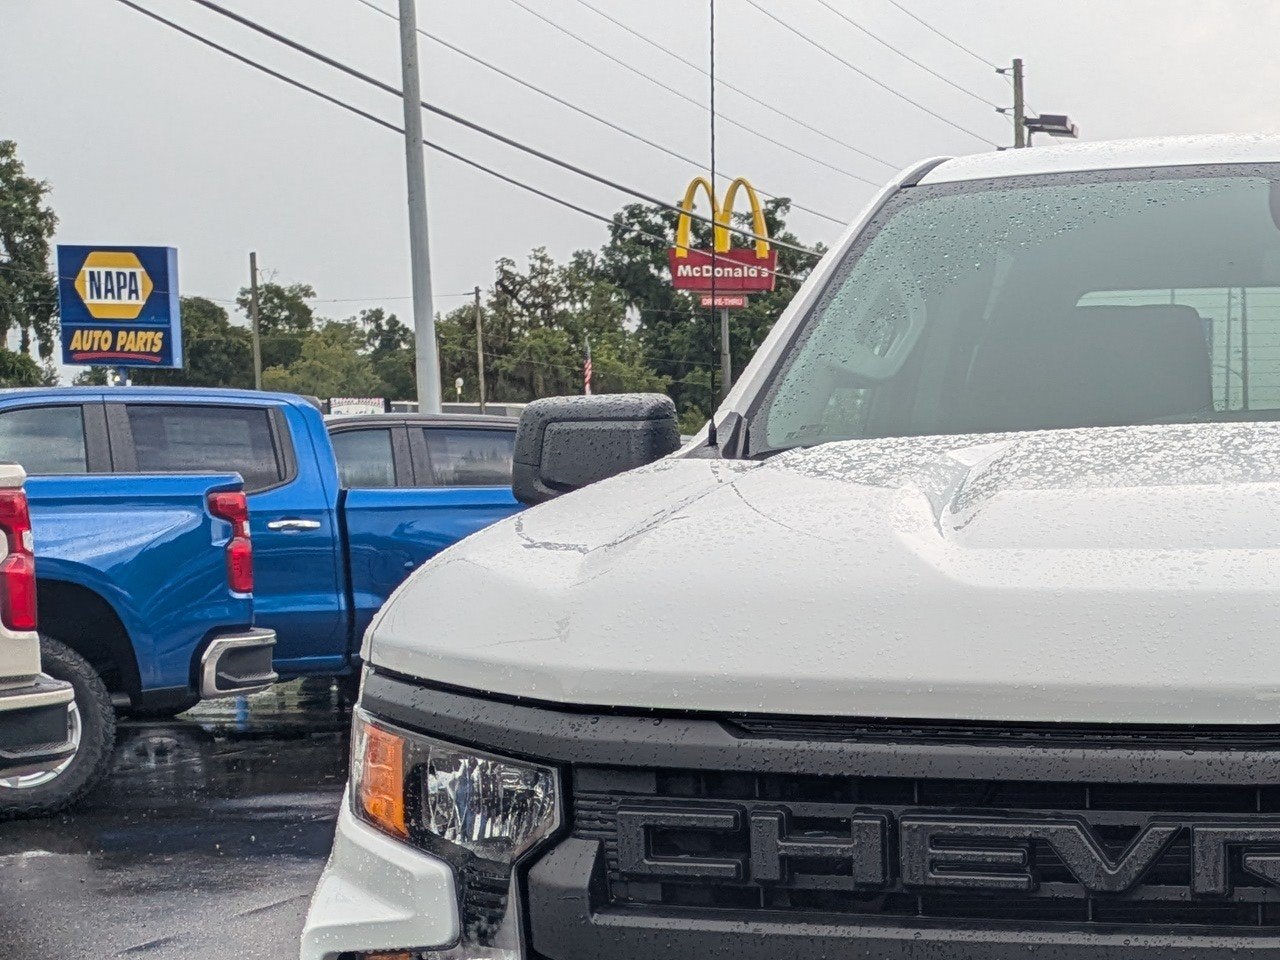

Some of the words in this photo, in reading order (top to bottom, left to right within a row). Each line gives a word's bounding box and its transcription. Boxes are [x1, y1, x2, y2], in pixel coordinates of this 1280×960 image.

[677, 265, 769, 278] McDonald's
[88, 270, 140, 300] NAPA
[701, 297, 743, 306] DRVE-THRU
[69, 329, 113, 351] AUTO
[115, 330, 164, 353] PARTS
